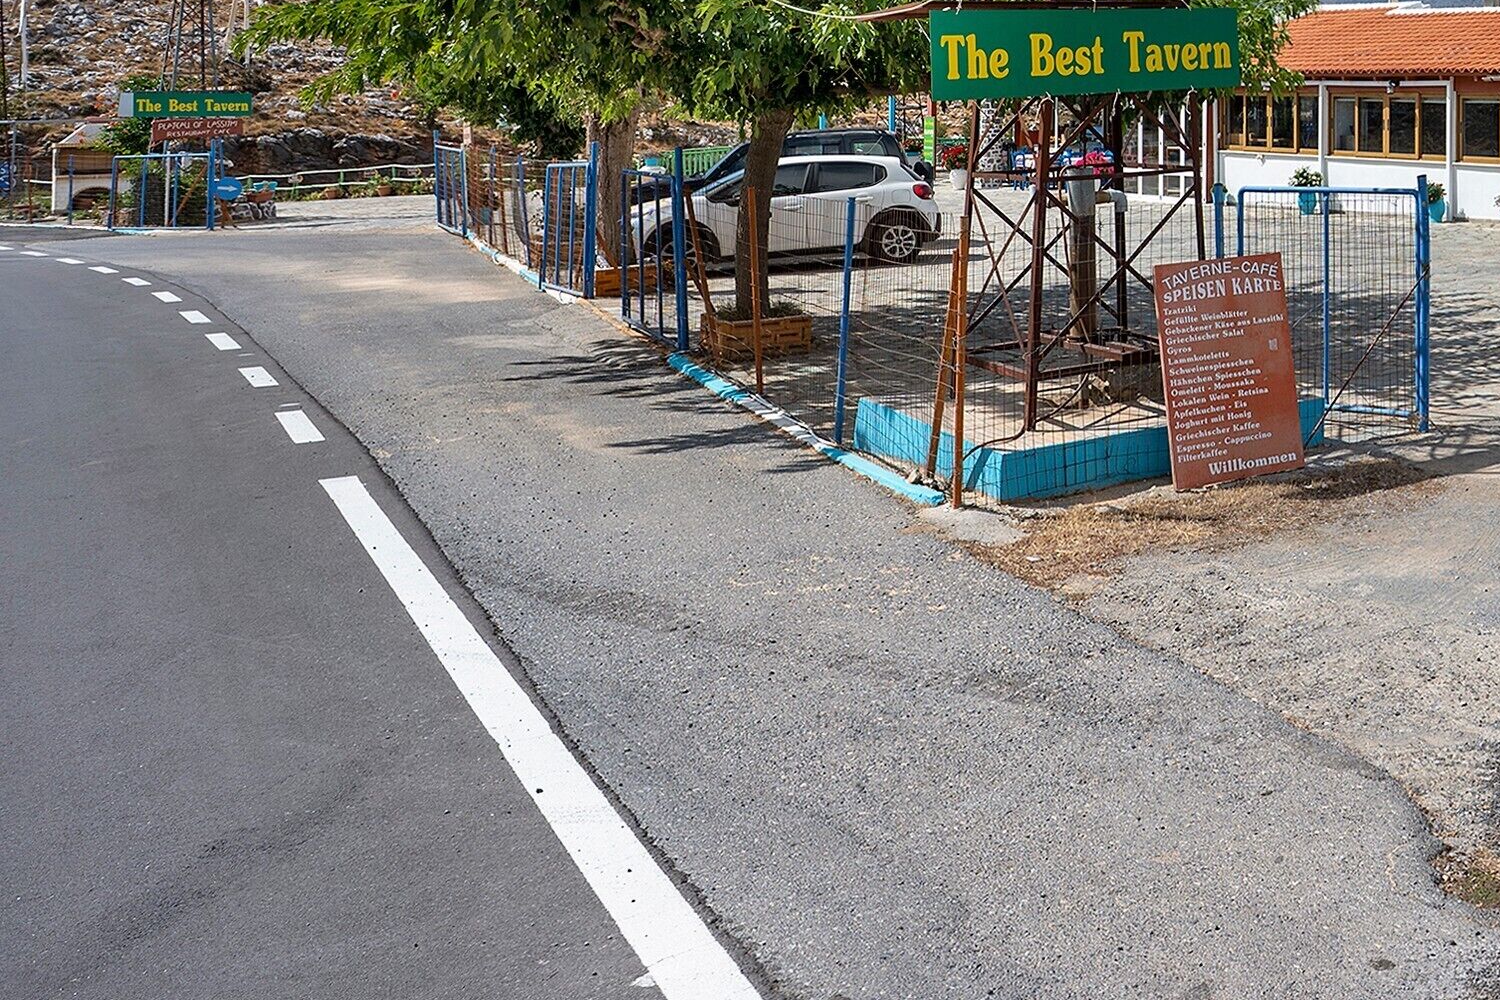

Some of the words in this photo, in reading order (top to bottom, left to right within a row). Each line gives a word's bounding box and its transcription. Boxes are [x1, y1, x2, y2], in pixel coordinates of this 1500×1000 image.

[940, 33, 1009, 80] The
[1029, 33, 1104, 76] Best
[1123, 31, 1232, 72] Tavern
[136, 99, 162, 112] The
[168, 99, 198, 112] Best
[204, 99, 248, 112] Tavern
[1162, 261, 1279, 290] TAVERNE-CAFÉ
[1164, 279, 1226, 303] SPEISEN
[1232, 277, 1281, 295] KARTE
[1163, 305, 1197, 316] Tzatziki
[1164, 316, 1198, 326] Gefüllte
[1201, 310, 1248, 322] Weinblätter
[1165, 325, 1212, 335] Gebackener
[1215, 321, 1235, 329] Käse
[1253, 314, 1284, 325] Lassithi
[1166, 333, 1220, 345] Griechischer
[1223, 329, 1244, 337] Salat
[1167, 346, 1192, 356] Gyros
[1168, 352, 1230, 365] Lammkoteletts
[1169, 359, 1254, 376] Schweinespiesschen
[1170, 376, 1213, 387] Hähnchen
[1215, 369, 1261, 382] Spiesschen
[1171, 386, 1205, 397] Omelett
[1214, 379, 1255, 390] Moussaka
[1172, 397, 1206, 408] Lokalen
[1209, 393, 1229, 401] Wein
[1238, 388, 1268, 397] Retsina
[1173, 406, 1226, 420] Apfelkuchen
[1234, 401, 1247, 409] Eis
[1175, 418, 1208, 430] Joghurt
[1211, 415, 1224, 423] mit
[1228, 411, 1252, 421] Honig
[1176, 427, 1230, 442] Griechischer
[1233, 422, 1261, 432] Kaffee
[1177, 441, 1216, 453] Espresso
[1224, 432, 1272, 445] Cappuccino
[1178, 449, 1228, 463] Filterkaffee
[1209, 452, 1297, 475] Willkommen
